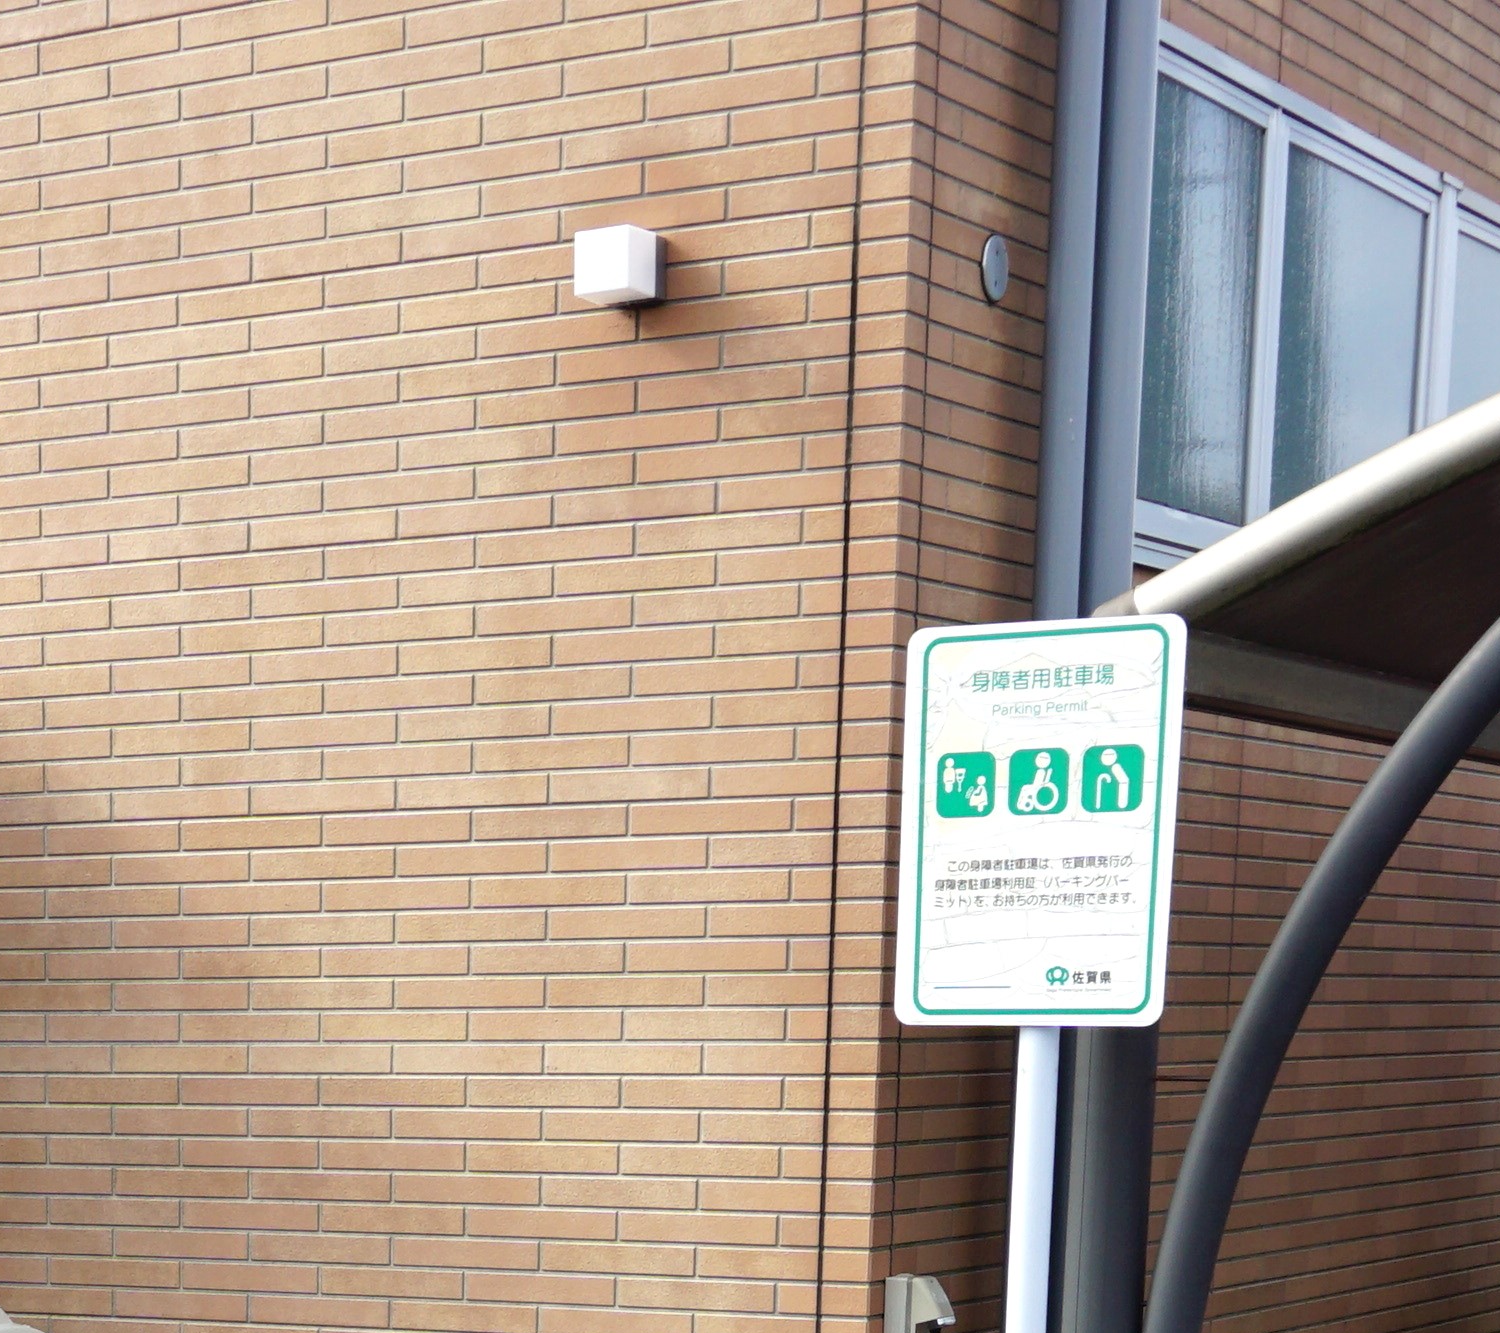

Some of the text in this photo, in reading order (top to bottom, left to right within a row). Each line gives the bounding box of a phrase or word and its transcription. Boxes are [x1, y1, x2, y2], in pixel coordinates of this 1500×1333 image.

[971, 663, 1115, 694] 身障者用駐車場
[991, 699, 1089, 717] Parking Permit
[1072, 970, 1112, 985] 佐賀県
